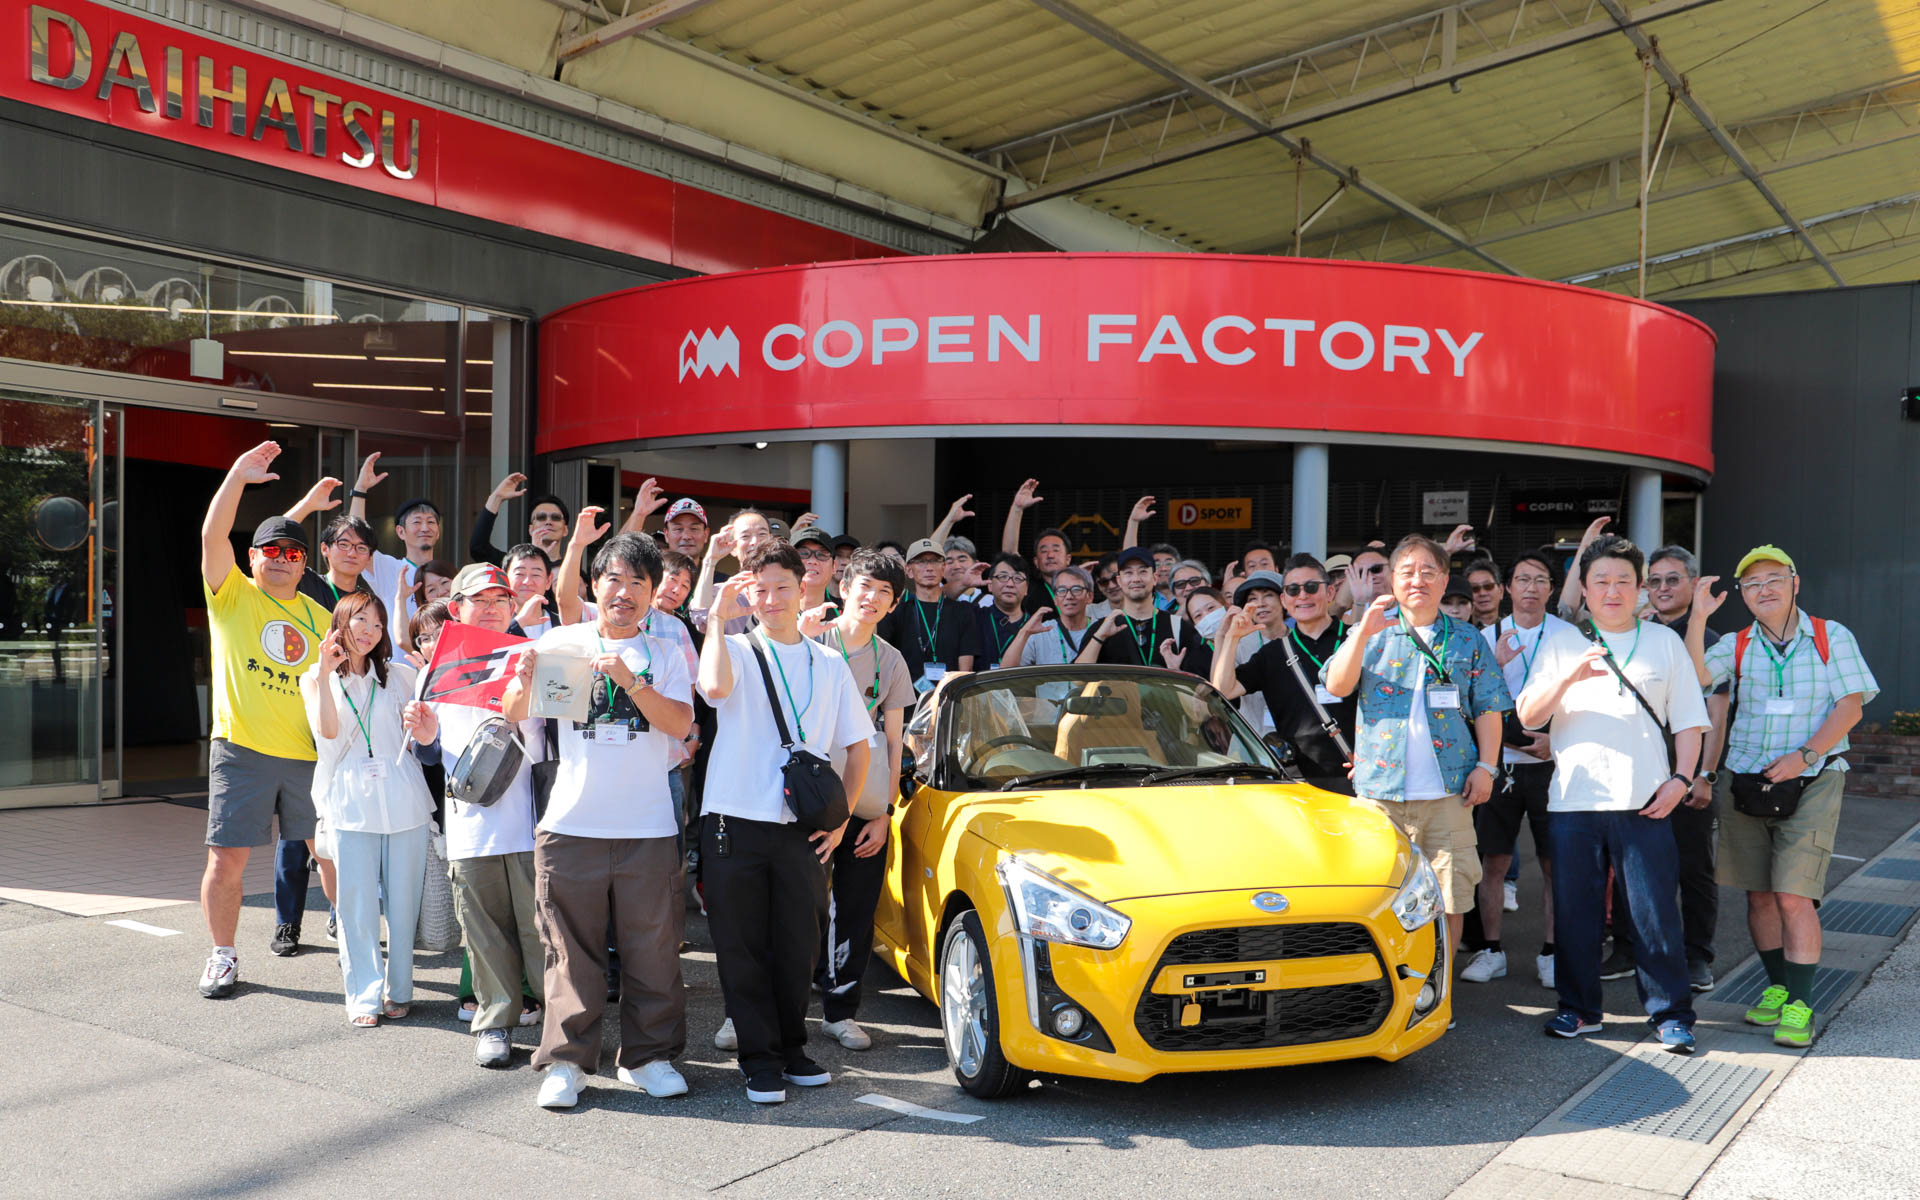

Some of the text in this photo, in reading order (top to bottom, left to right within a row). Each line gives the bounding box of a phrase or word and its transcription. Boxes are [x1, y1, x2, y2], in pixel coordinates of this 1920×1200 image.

[29, 4, 420, 180] DAIHATSU
[762, 313, 1485, 377] COPEN FACTORY
[1200, 508, 1243, 520] SPORT
[1529, 503, 1574, 512] COPEN
